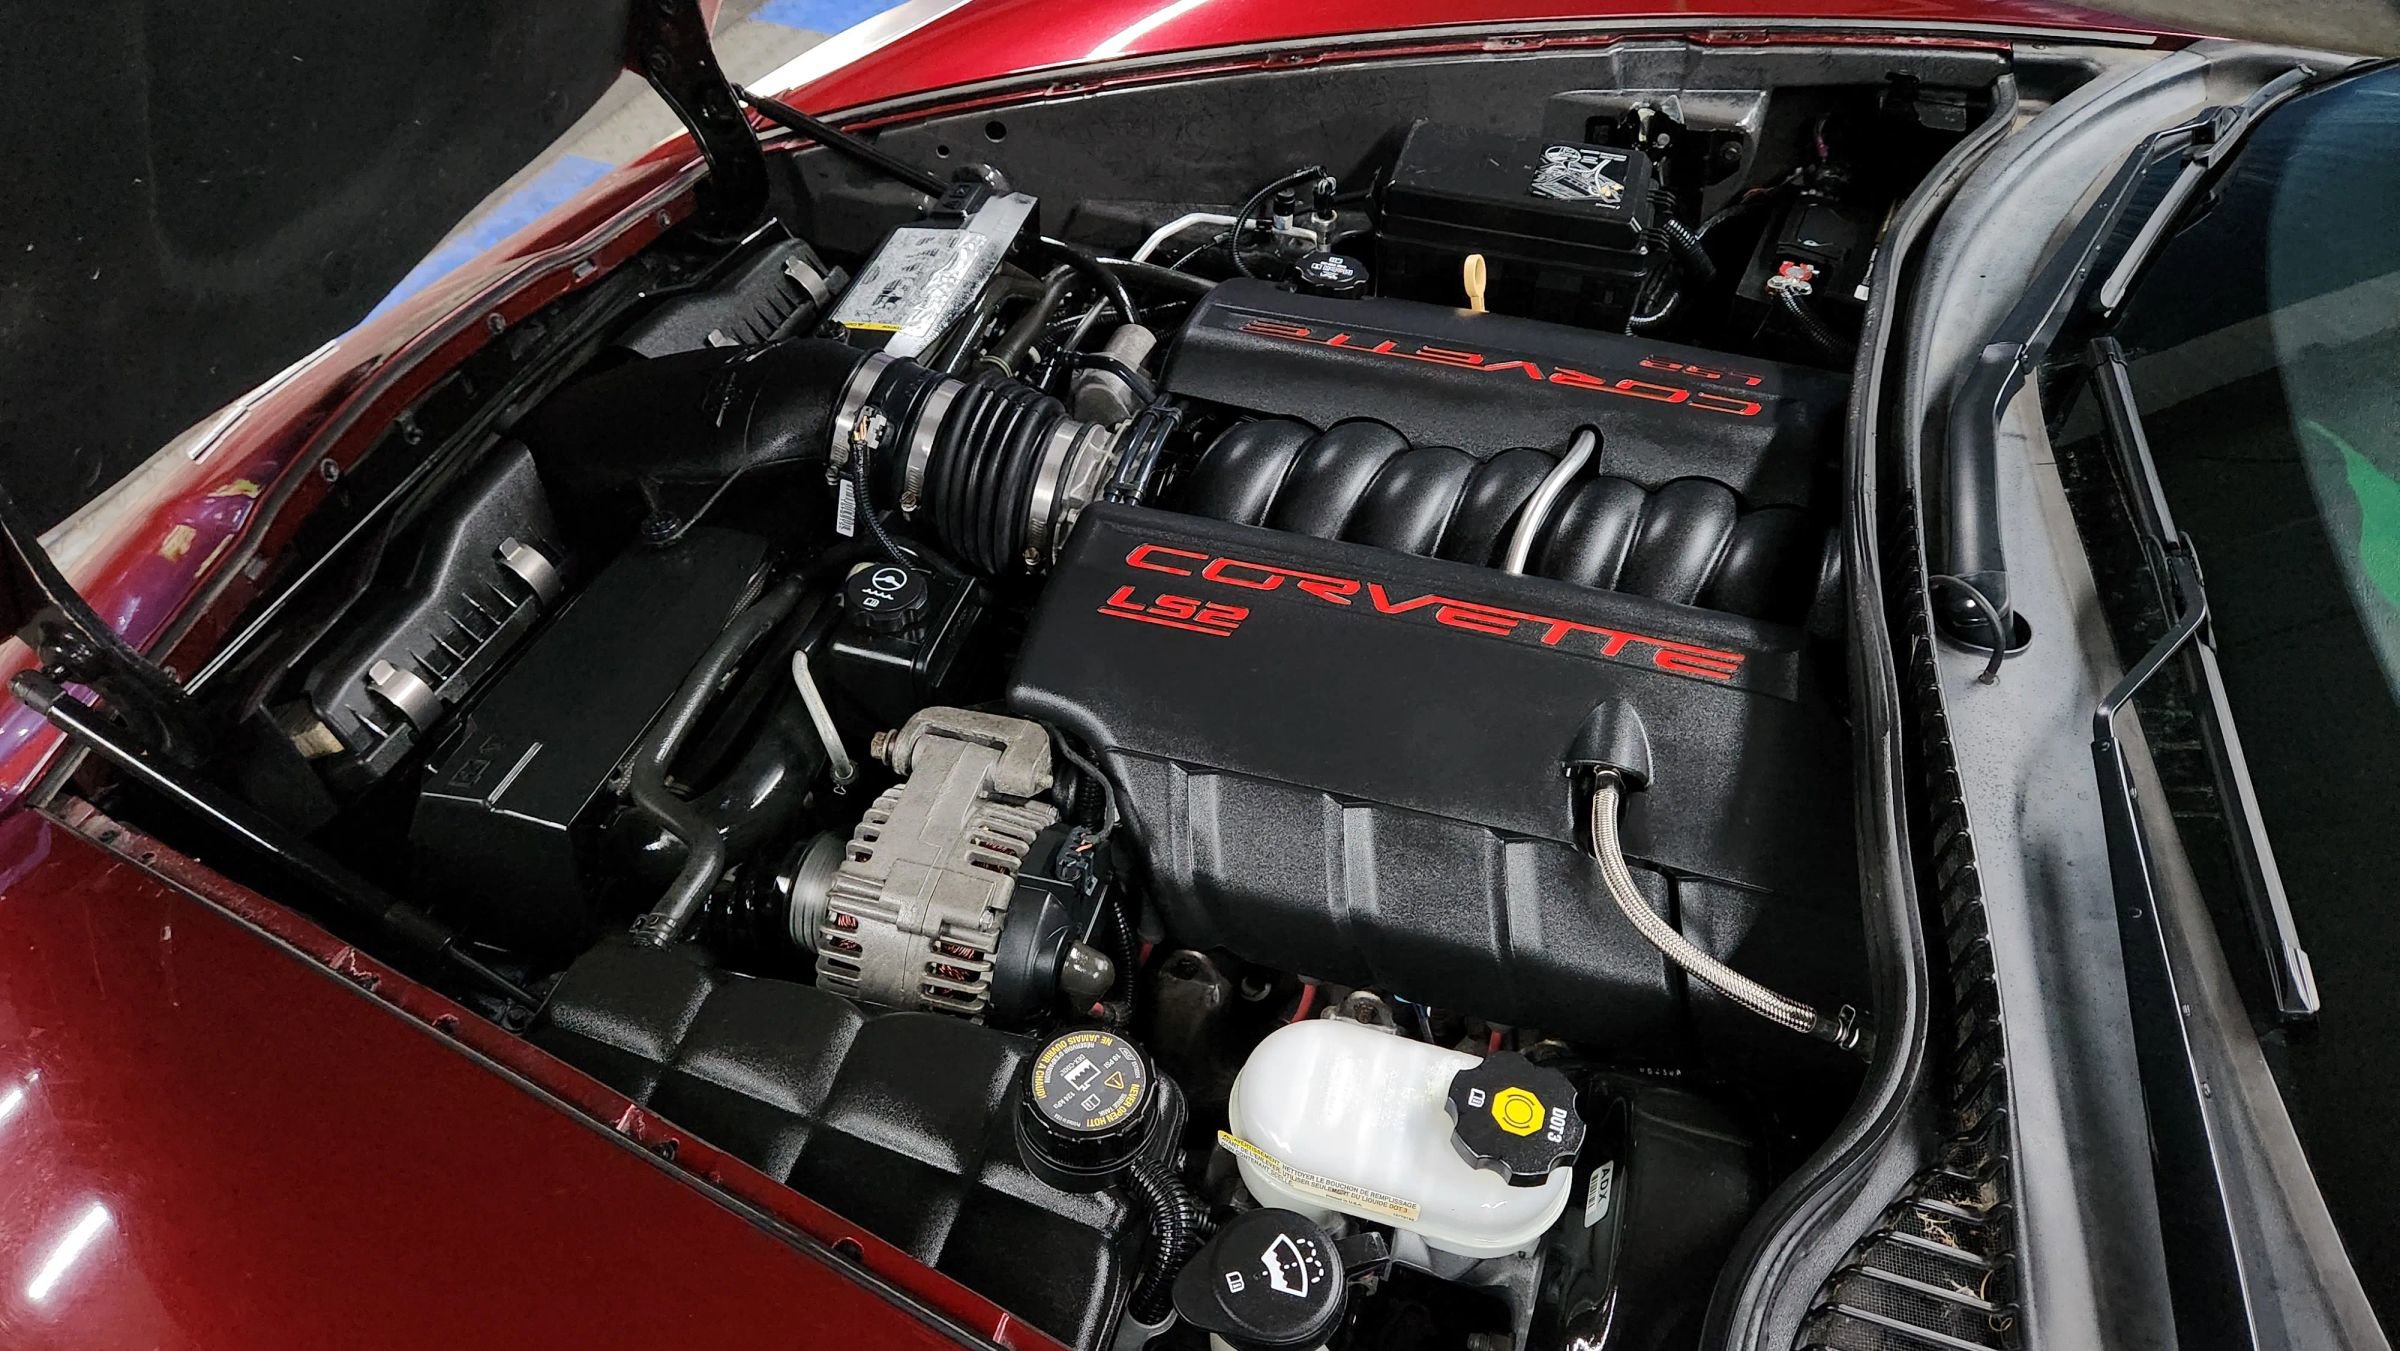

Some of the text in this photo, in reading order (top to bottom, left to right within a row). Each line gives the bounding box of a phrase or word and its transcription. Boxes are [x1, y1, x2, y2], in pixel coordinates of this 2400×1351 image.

[1239, 317, 1763, 417] CORVETTE
[1639, 356, 1763, 386] LS2
[1106, 585, 1250, 624] LS2
[1125, 543, 1746, 681] CORVETTE
[1067, 1034, 1100, 1045] JAMAIS
[1101, 1036, 1113, 1047] NE
[1041, 1040, 1067, 1064] OUVRIR
[1103, 1058, 1115, 1069] PSI
[1123, 1083, 1140, 1107] NEVER
[1106, 1106, 1127, 1122] OPEN
[1282, 1164, 1315, 1182] NETTOYER
[1326, 1179, 1359, 1193] BOUCHON
[1370, 1191, 1417, 1210] REMPLISSAGE
[1361, 1196, 1389, 1208] LIQUIDE
[1388, 1203, 1402, 1212] DOT
